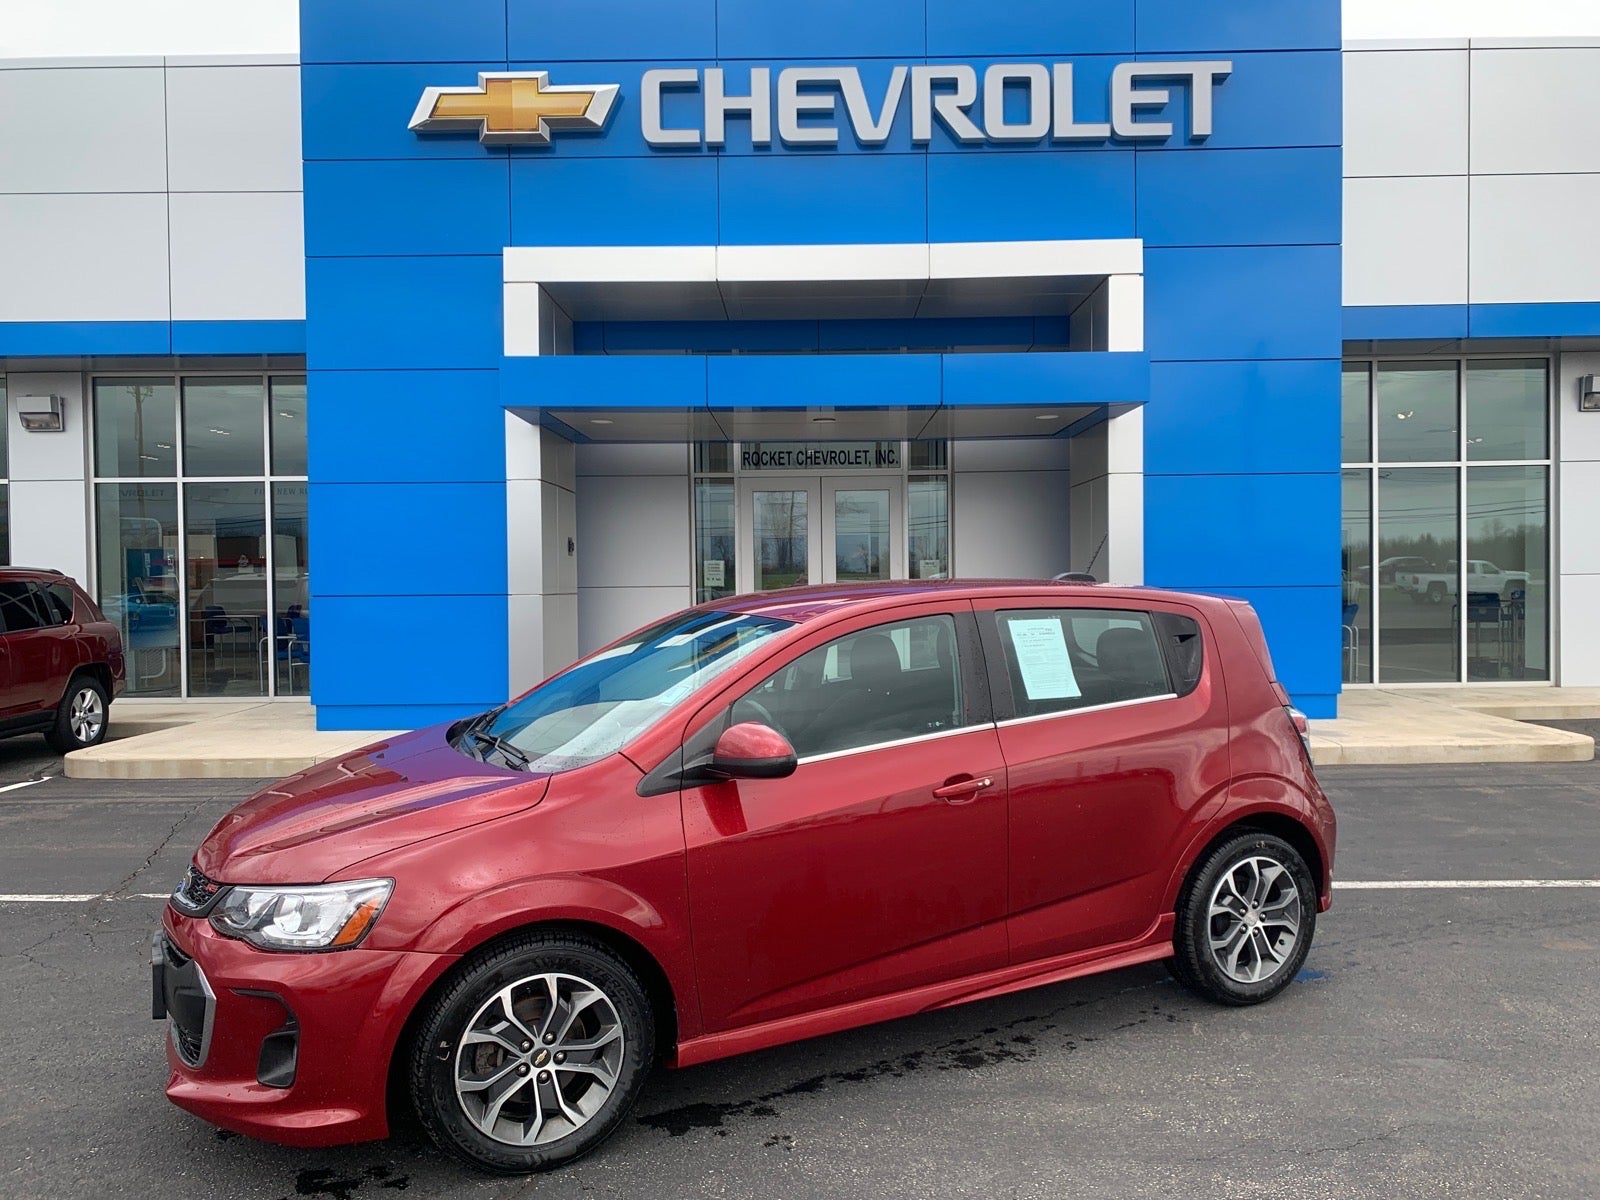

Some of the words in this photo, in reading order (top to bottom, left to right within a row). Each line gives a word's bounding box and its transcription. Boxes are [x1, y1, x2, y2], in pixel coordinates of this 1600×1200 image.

[642, 61, 1233, 146] CHEVROLET
[742, 450, 793, 466] ROCKET
[796, 449, 872, 467] CHEVROLET,
[875, 449, 899, 465] INC.
